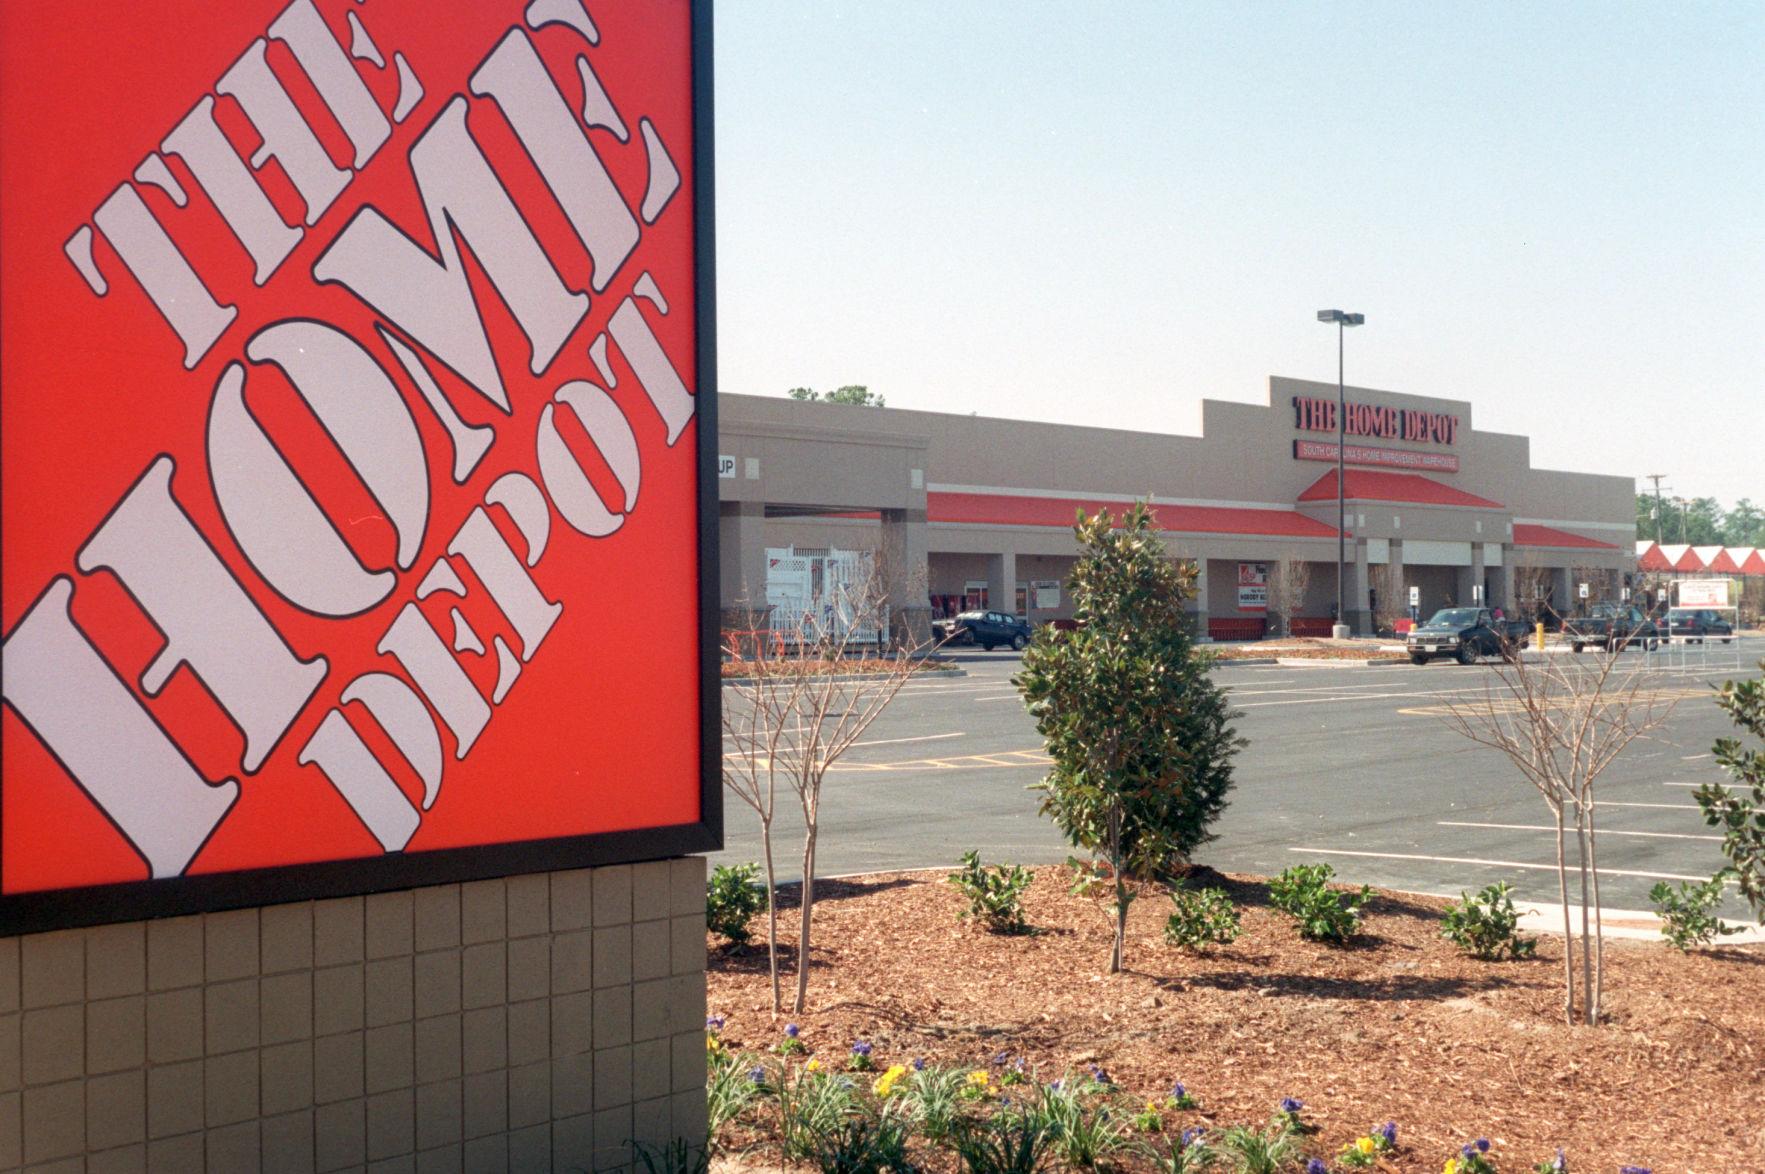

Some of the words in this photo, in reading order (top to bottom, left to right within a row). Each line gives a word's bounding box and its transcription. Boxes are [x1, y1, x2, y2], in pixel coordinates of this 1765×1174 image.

[64, 0, 425, 370] THE
[1, 0, 682, 880] HOME
[297, 270, 695, 853] DEPOT
[1294, 397, 1336, 432] THE
[1342, 402, 1398, 439] HOME
[1401, 410, 1460, 445] DEPOT
[1303, 445, 1324, 456] SOUTH
[1326, 447, 1360, 459] CARLINA'S
